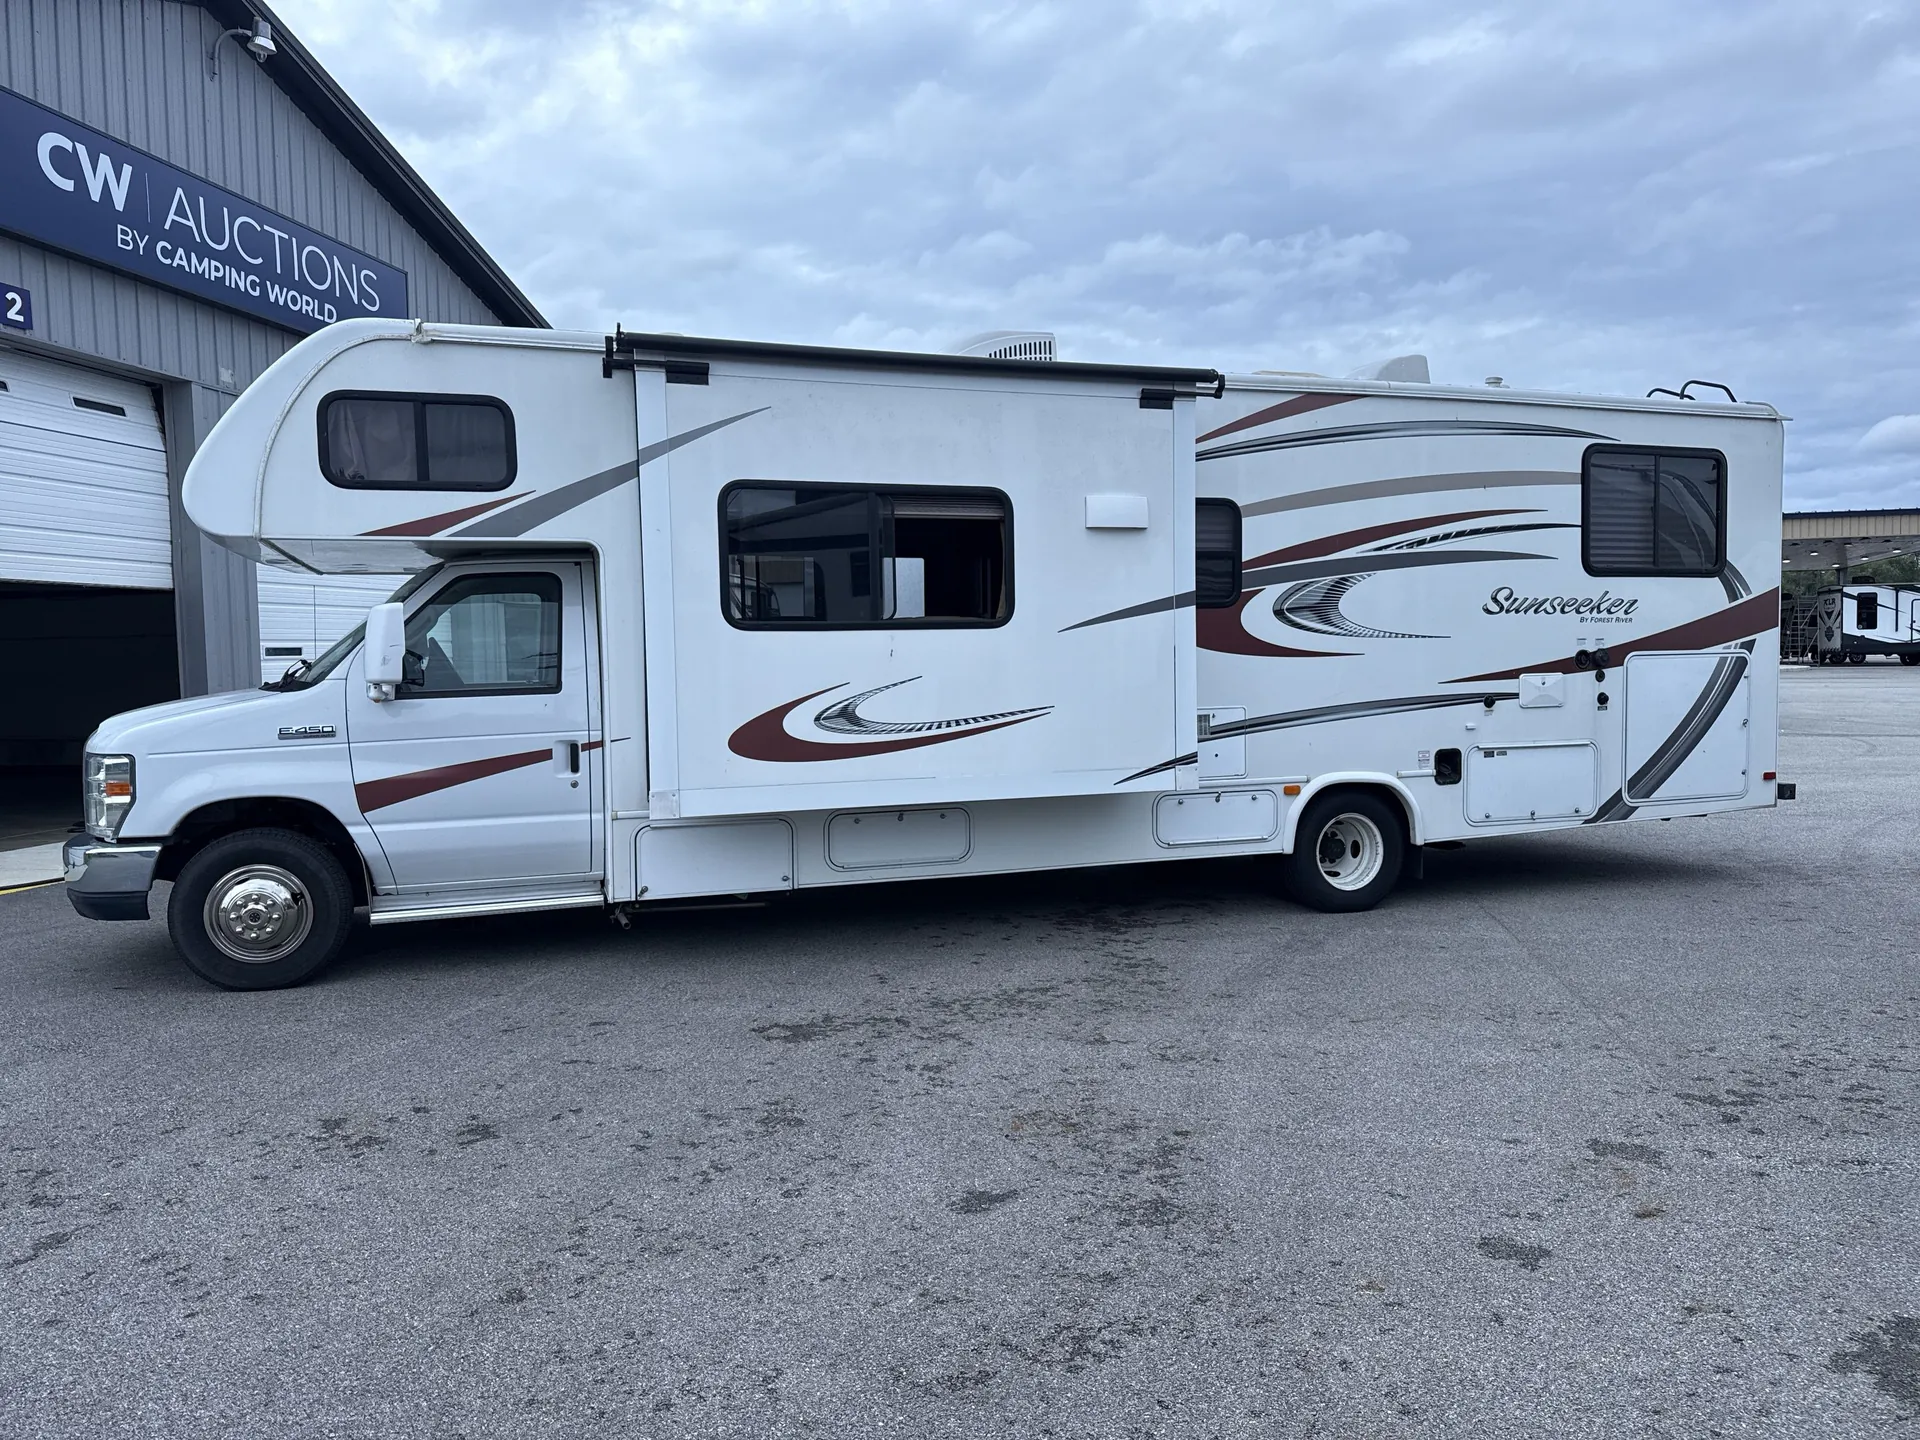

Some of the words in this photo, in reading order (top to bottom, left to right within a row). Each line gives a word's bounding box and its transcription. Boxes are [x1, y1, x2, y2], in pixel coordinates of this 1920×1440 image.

[37, 131, 133, 213] CW
[164, 187, 380, 312] AUCTIONS
[117, 223, 149, 255] BY
[156, 240, 260, 297] CAMPING
[266, 280, 338, 324] WORLD
[5, 291, 25, 323] 2
[1482, 586, 1639, 616] Sunseeker
